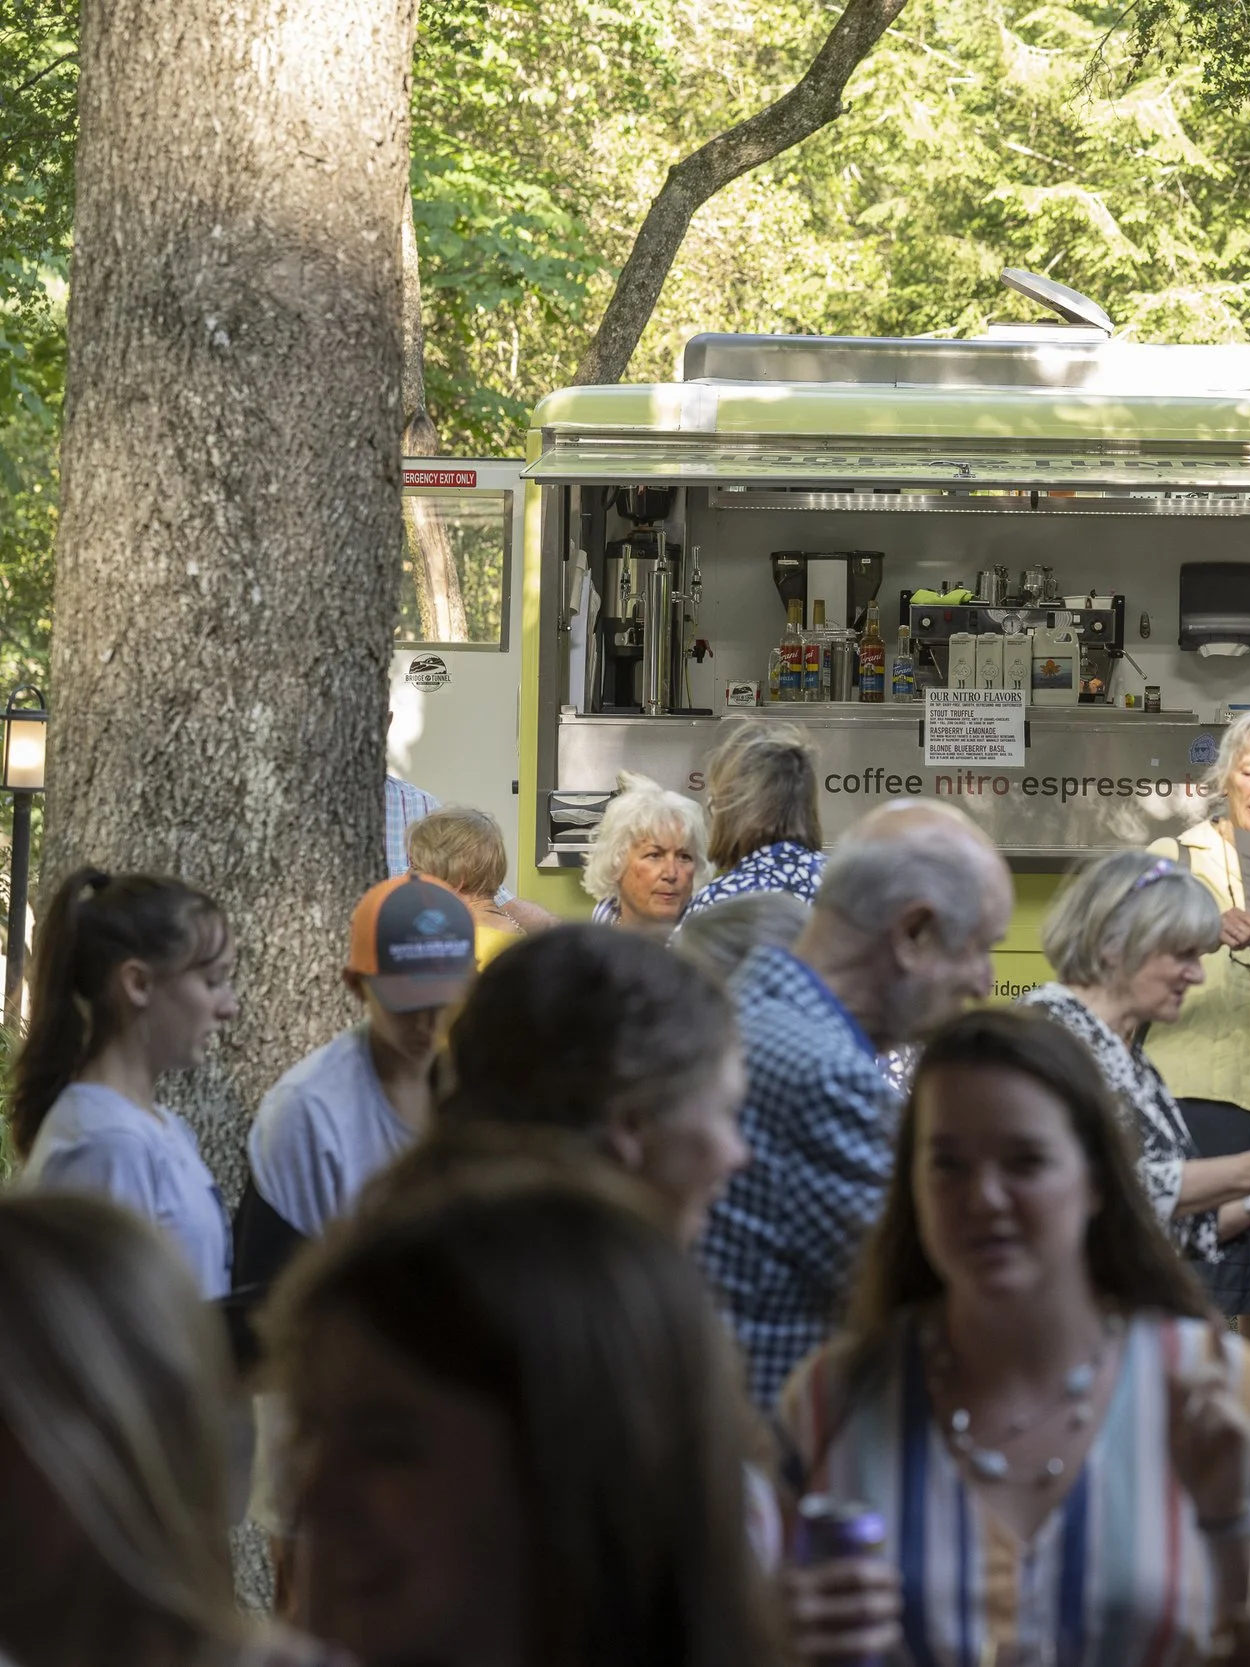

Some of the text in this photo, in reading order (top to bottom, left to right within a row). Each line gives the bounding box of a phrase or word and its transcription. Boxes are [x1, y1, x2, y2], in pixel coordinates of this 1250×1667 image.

[403, 472, 475, 484] ERGENCY EXIT ONLY
[930, 692, 1022, 702] OUR NITRO FLAVORS
[989, 745, 1006, 753] BASIL
[824, 767, 923, 794] coffee
[935, 768, 1010, 795] nitro
[1021, 775, 1172, 803] espresso
